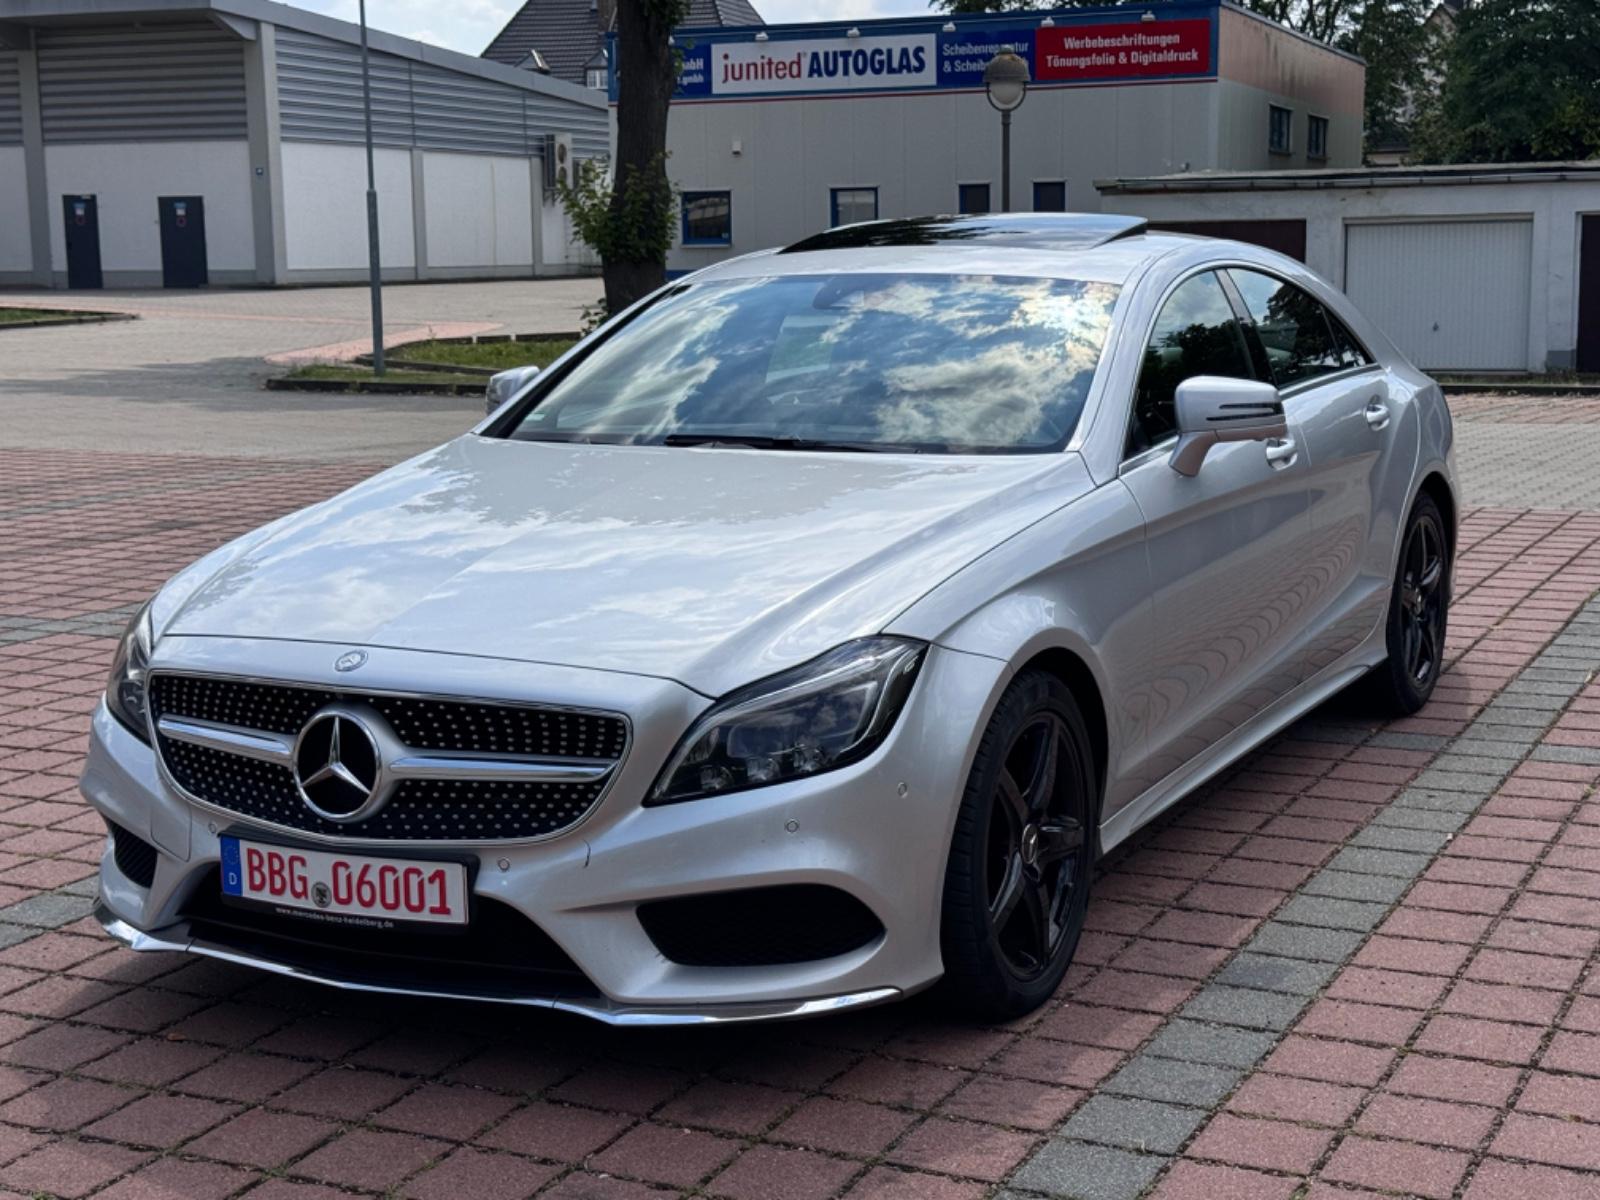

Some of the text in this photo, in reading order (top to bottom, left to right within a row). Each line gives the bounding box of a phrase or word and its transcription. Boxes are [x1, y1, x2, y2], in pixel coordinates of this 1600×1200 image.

[1064, 33, 1180, 50] Werbebeschriftungen
[807, 45, 926, 79] AUTOGLAS
[943, 60, 952, 73] &
[1046, 47, 1199, 69] Tönungsfolie & Digitaldruck
[228, 872, 238, 885] D
[246, 848, 452, 916] BBG 06001
